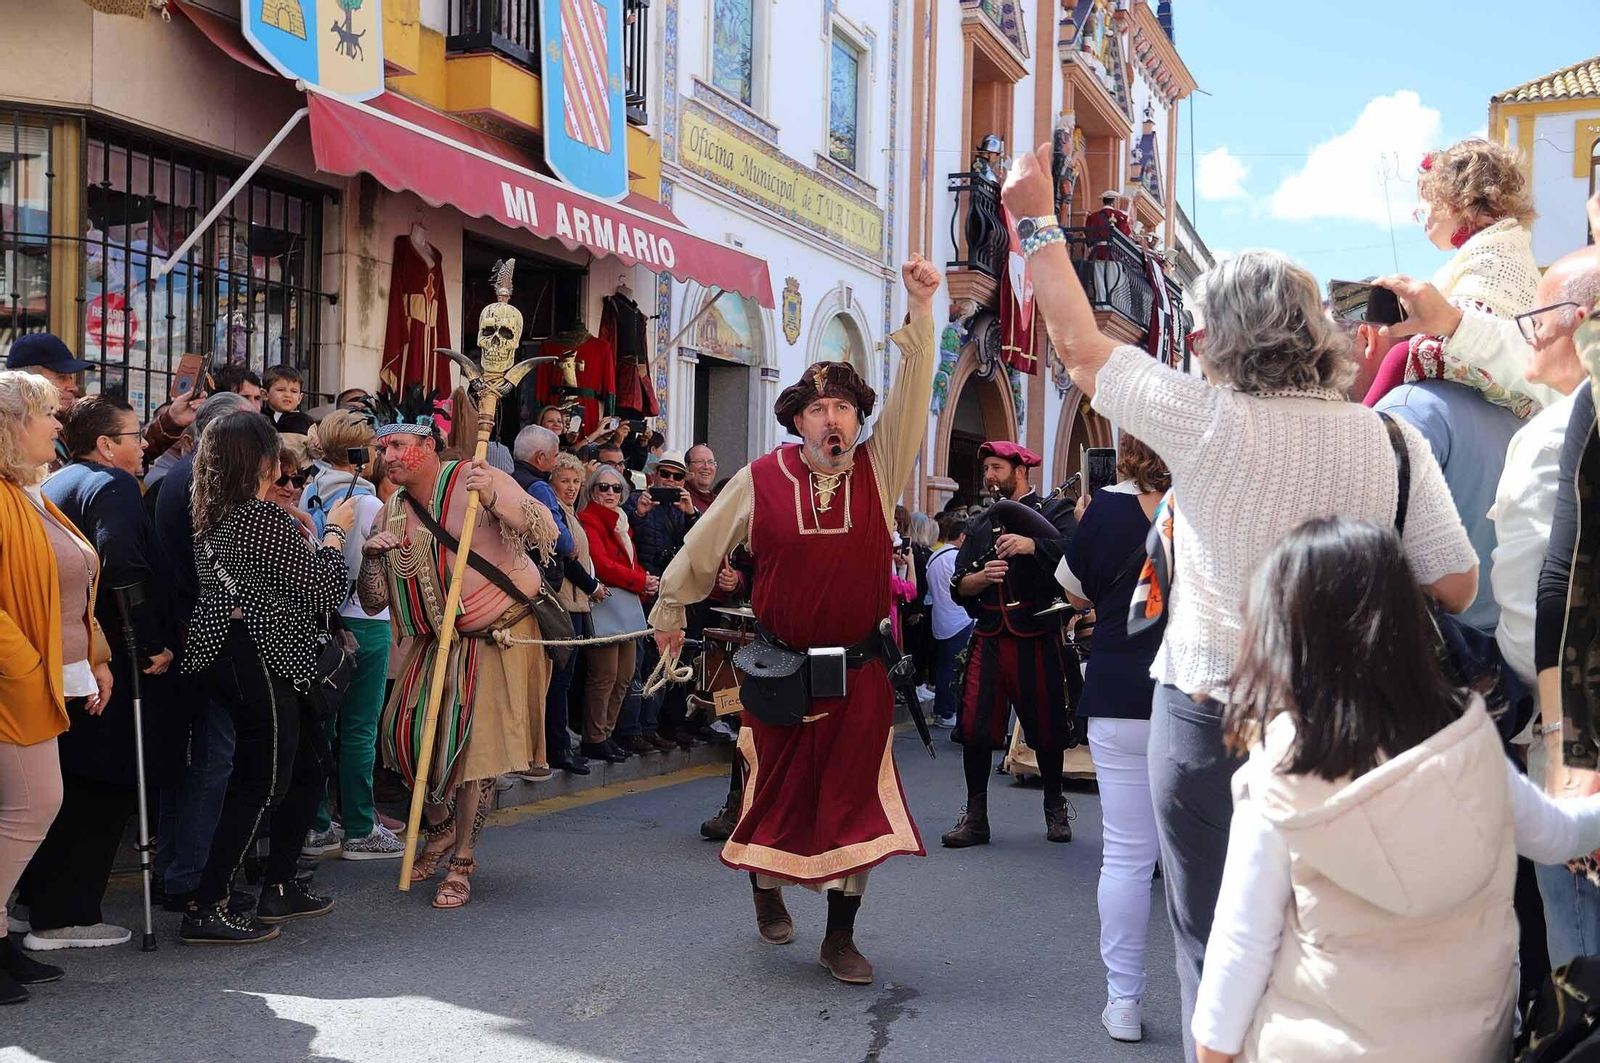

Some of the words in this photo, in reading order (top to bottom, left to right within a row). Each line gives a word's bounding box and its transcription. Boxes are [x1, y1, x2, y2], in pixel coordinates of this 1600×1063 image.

[690, 126, 734, 171] Oficina
[739, 154, 799, 204] Municipal
[802, 187, 812, 212] de
[501, 181, 539, 227] MI
[556, 202, 676, 269] ARMARIO
